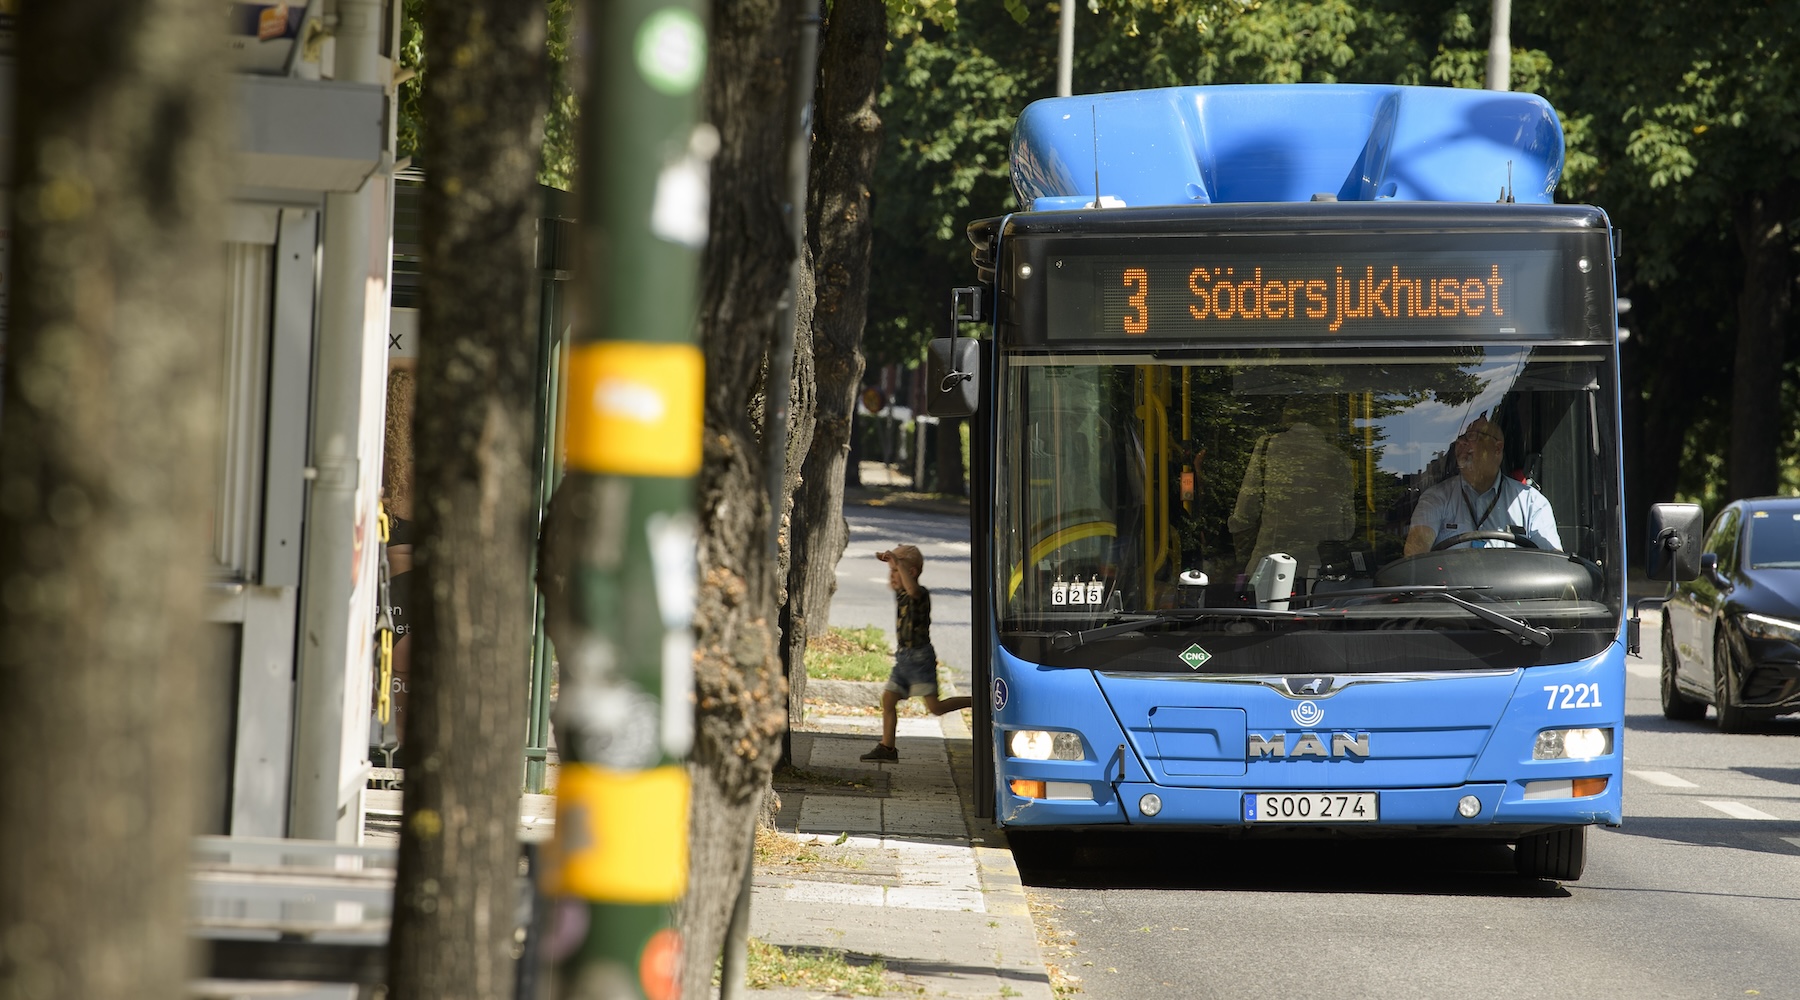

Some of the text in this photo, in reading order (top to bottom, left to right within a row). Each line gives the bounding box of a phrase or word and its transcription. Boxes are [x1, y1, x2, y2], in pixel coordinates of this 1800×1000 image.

[1123, 264, 1504, 334] 3 Södersjukhuset
[1185, 652, 1205, 660] CNG
[1543, 683, 1602, 710] 7221
[1301, 705, 1314, 715] SL
[1249, 732, 1370, 757] MAN
[1266, 797, 1311, 817] SOO
[1320, 796, 1366, 817] 274
